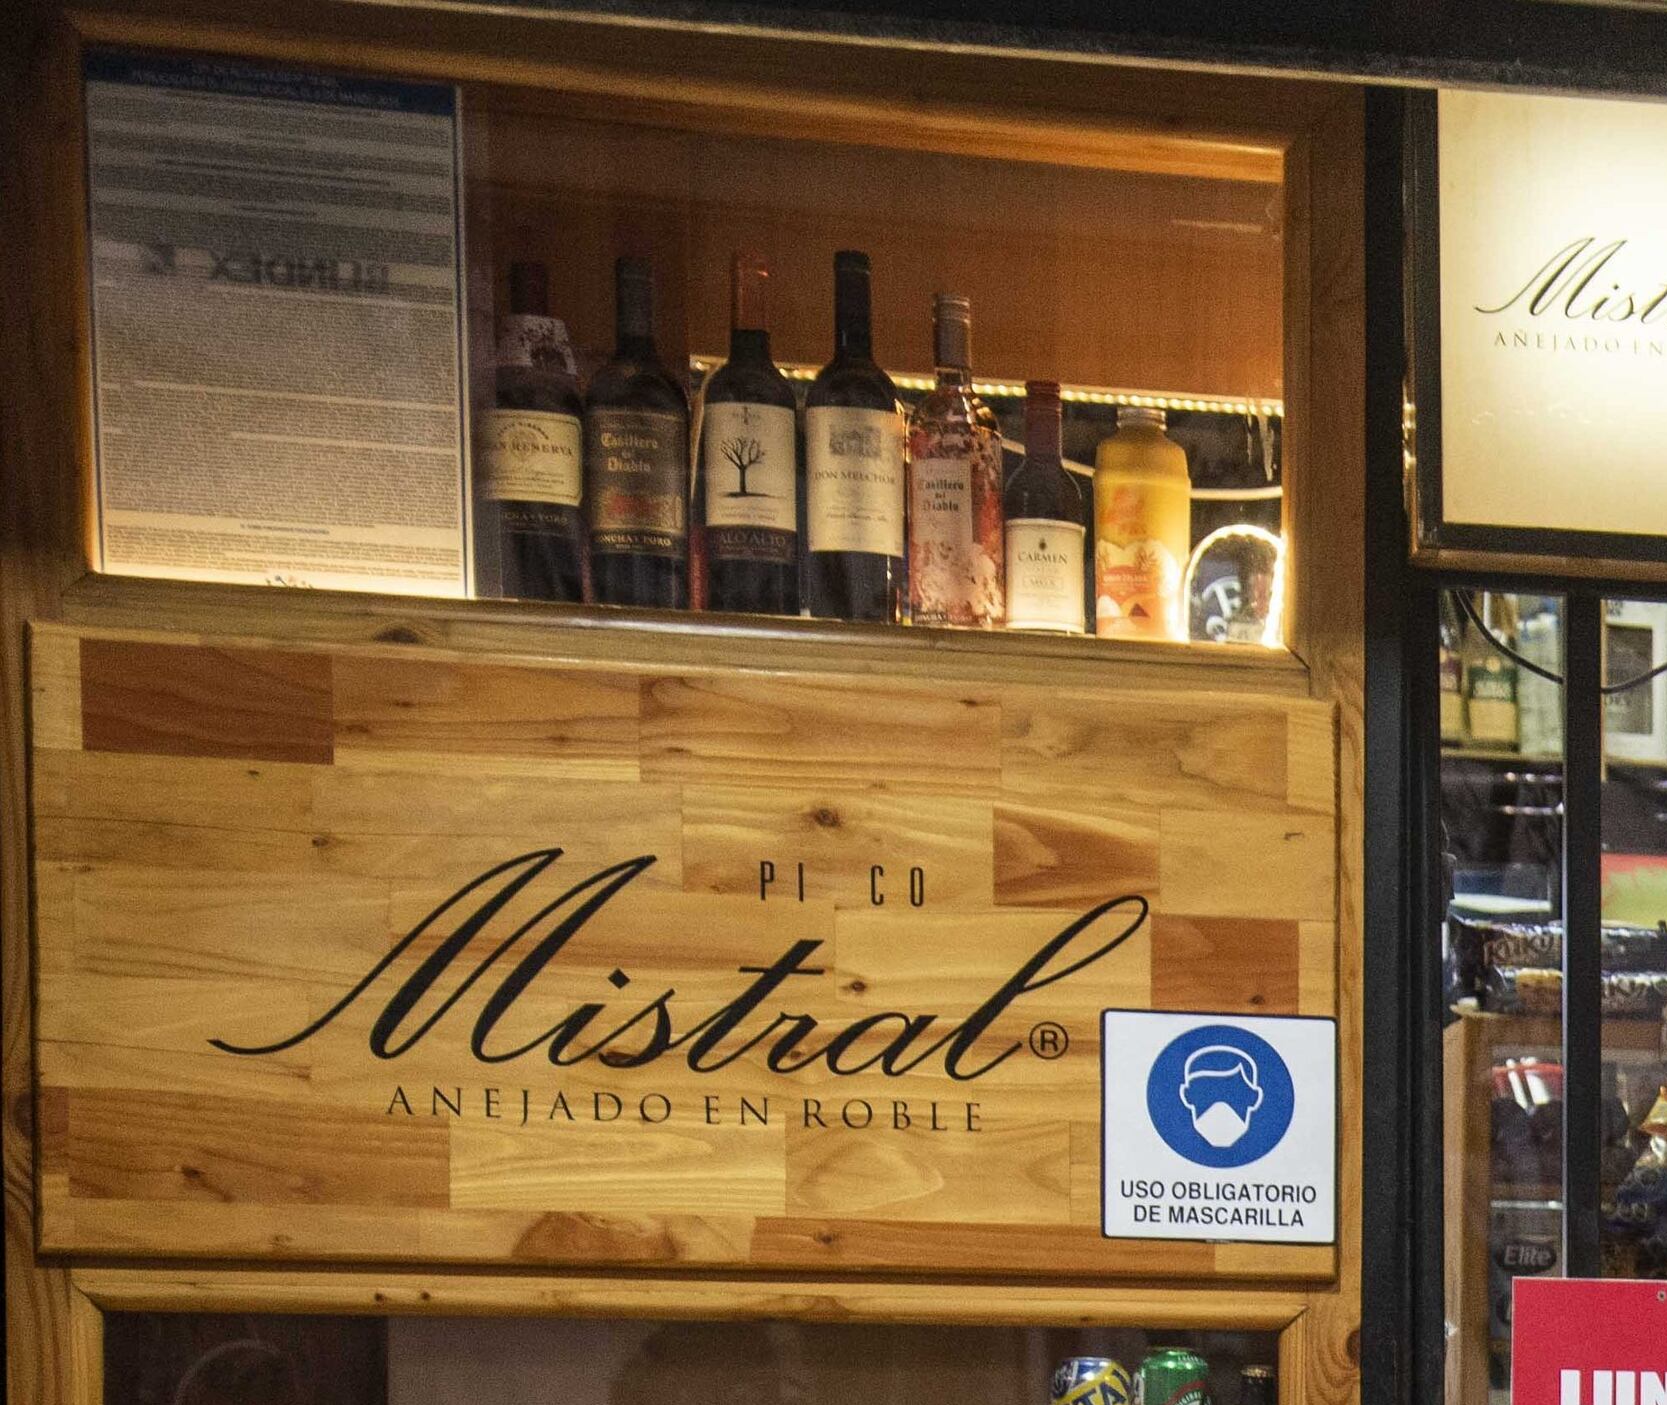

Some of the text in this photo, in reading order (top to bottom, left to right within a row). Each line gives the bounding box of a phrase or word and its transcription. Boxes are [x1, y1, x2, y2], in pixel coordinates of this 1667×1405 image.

[1017, 551, 1069, 566] CARMEN
[207, 847, 1149, 1082] Mistral
[705, 1094, 770, 1128] EN
[803, 1097, 983, 1133] ROBLE
[1120, 1179, 1317, 1204] USO OBLIGATORIO
[1133, 1204, 1304, 1227] DE MASCARILLA
[1504, 1245, 1551, 1267] Elite
